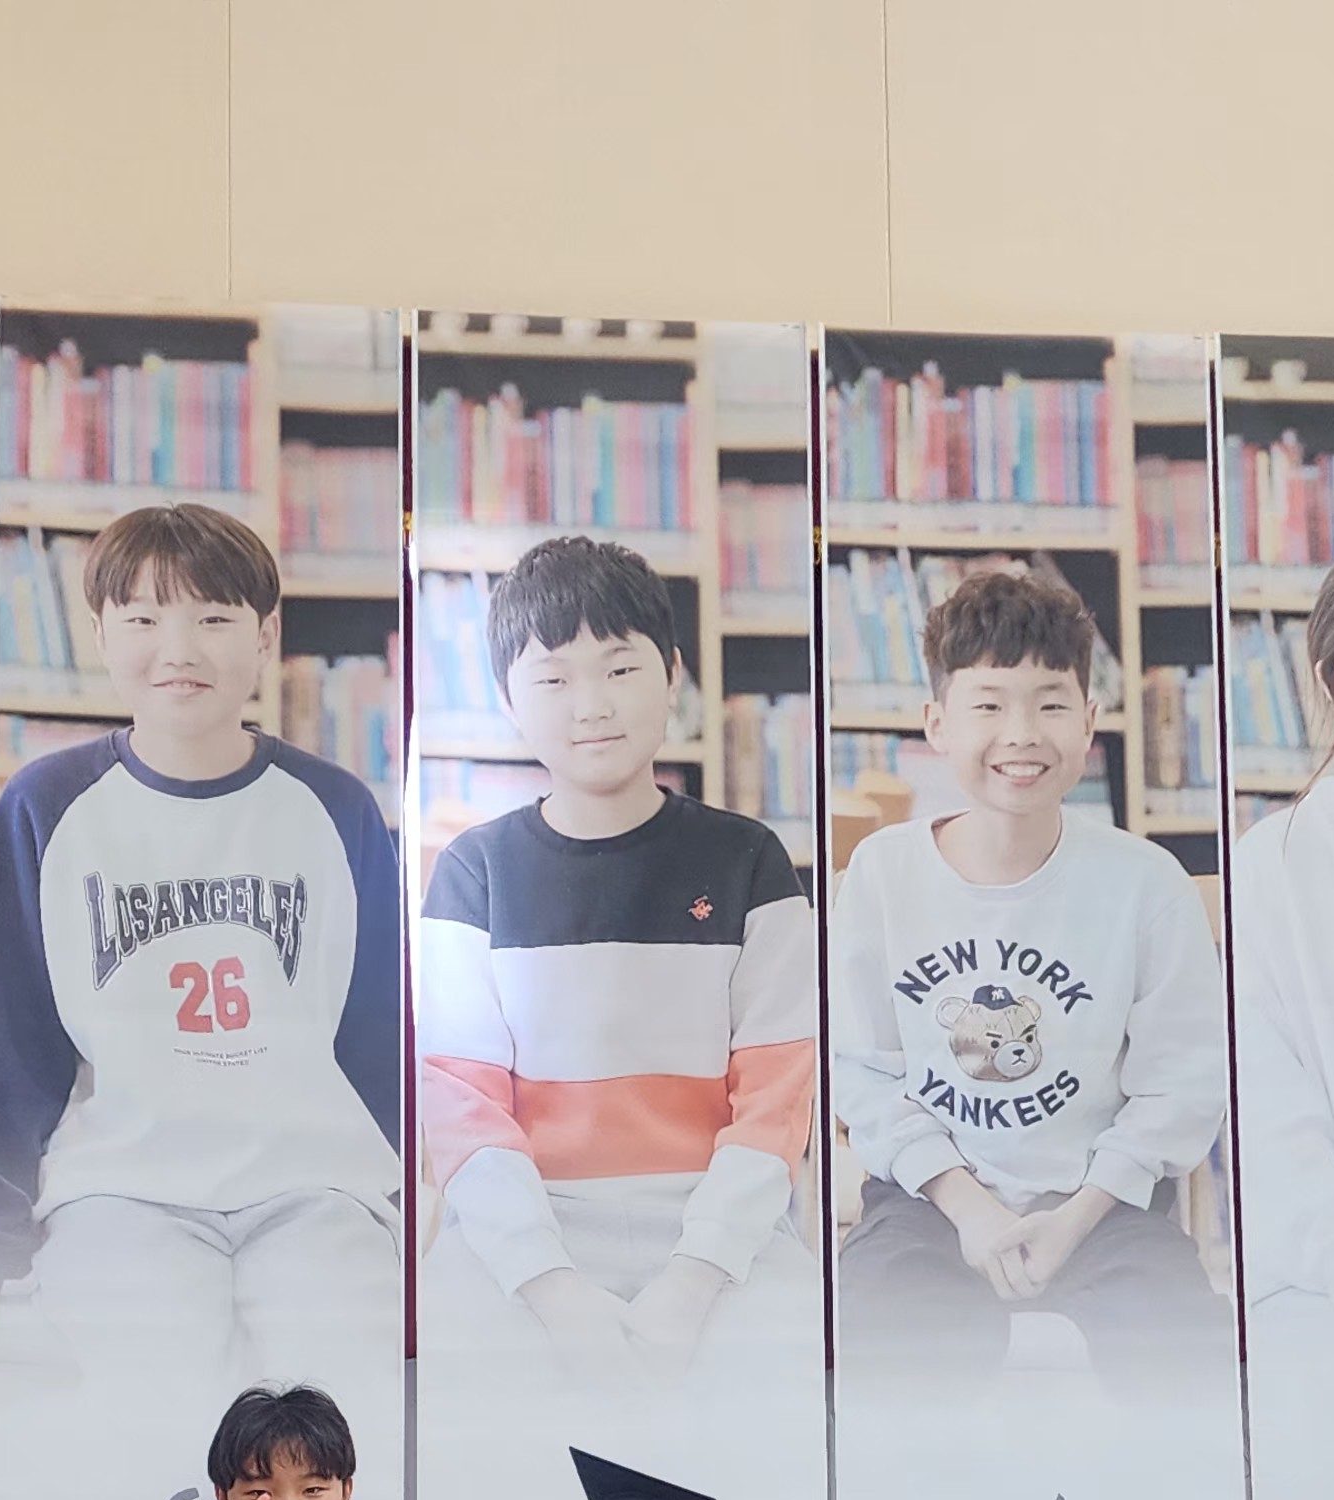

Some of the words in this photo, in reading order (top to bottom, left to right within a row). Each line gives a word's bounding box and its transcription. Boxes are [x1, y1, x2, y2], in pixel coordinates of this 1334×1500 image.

[170, 956, 250, 1033] 26
[894, 939, 978, 1005] NEW
[996, 939, 1093, 1014] YORK
[919, 1068, 1080, 1130] YANKEES
